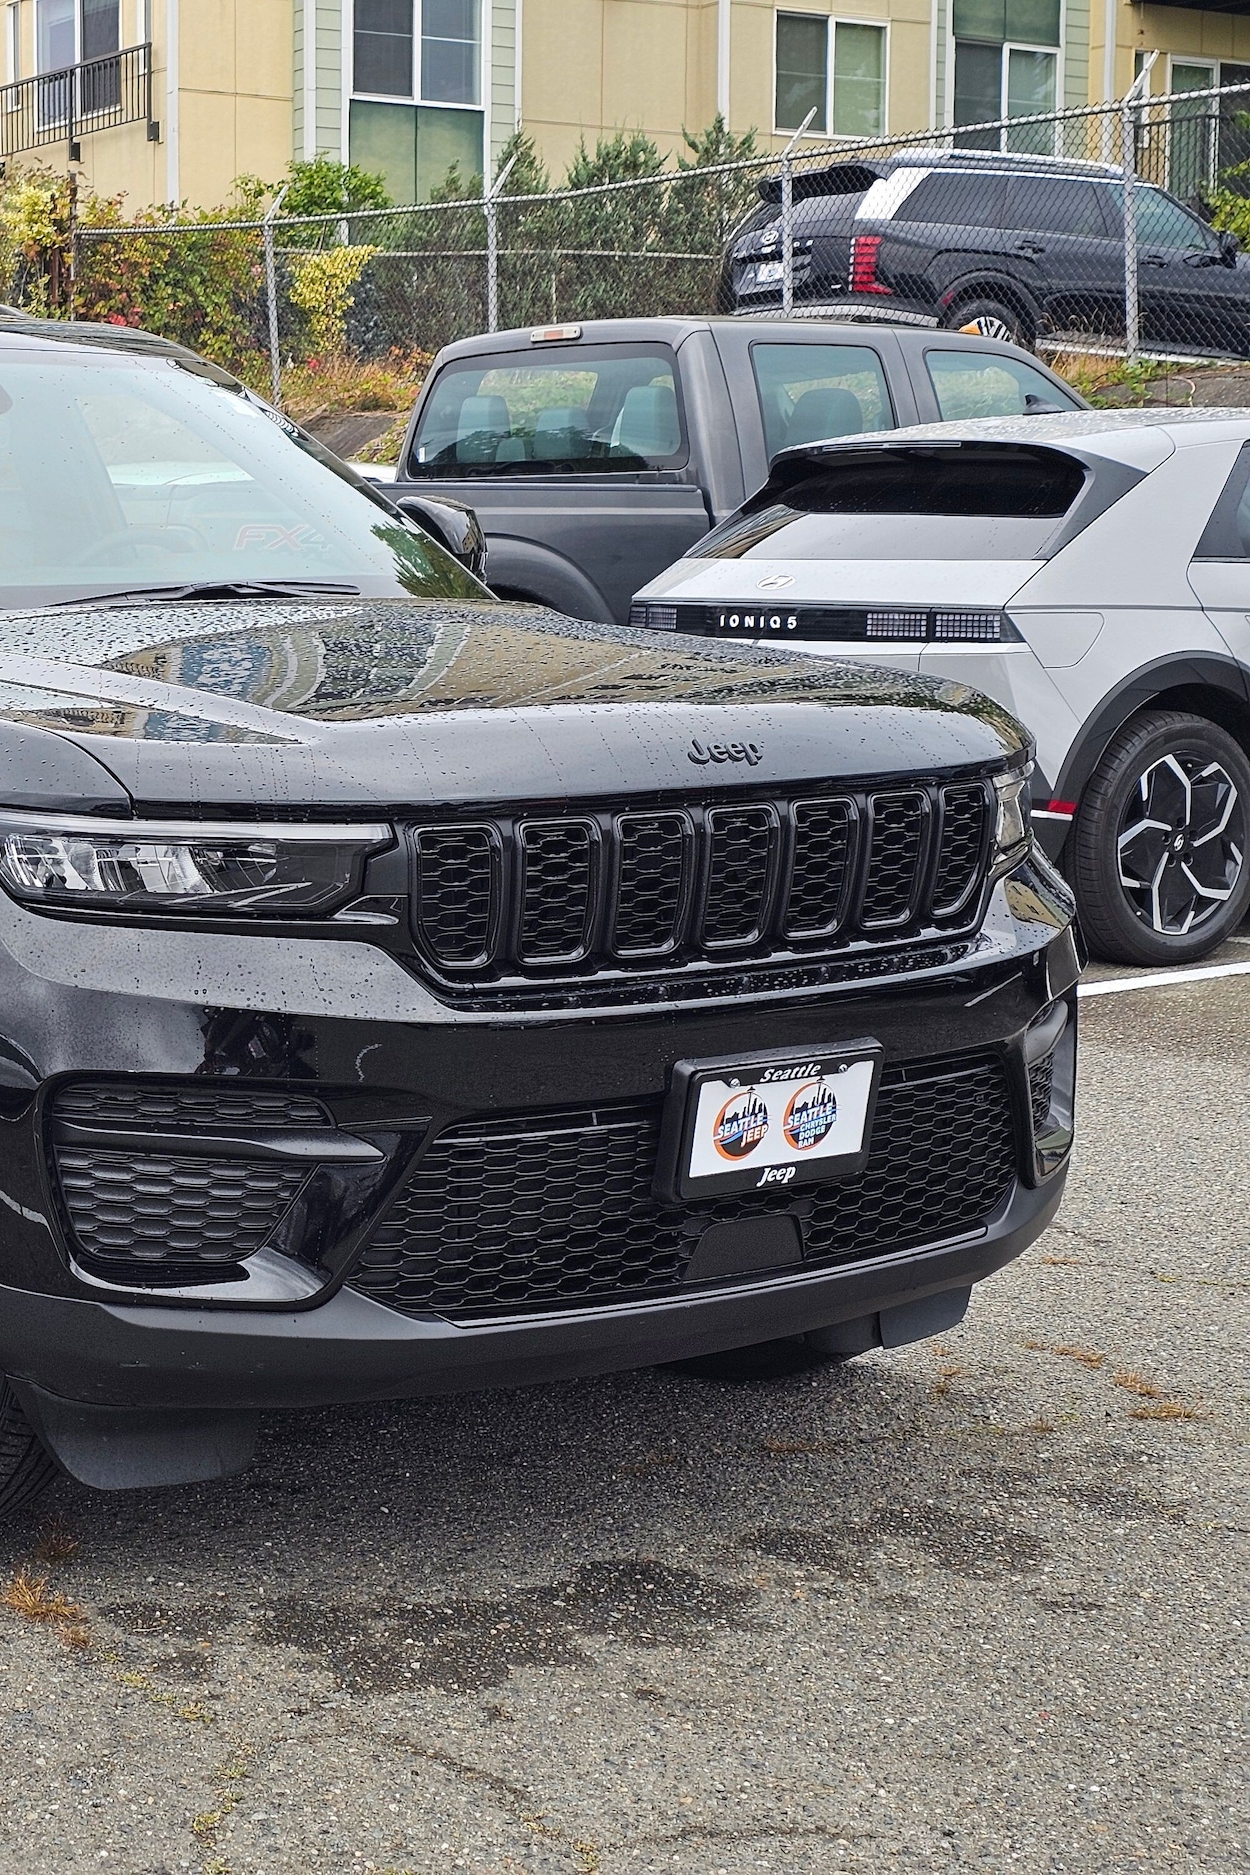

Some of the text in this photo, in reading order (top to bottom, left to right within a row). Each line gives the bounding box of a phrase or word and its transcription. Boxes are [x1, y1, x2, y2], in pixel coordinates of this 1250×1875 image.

[719, 614, 798, 630] IONIQ 5
[687, 738, 763, 766] Jeep
[759, 1062, 822, 1083] Seattle
[716, 1112, 765, 1139] SEATTLE
[787, 1102, 834, 1128] SEATTLE
[800, 1114, 837, 1132] CHRYSLER
[740, 1124, 769, 1148] JEEP
[798, 1125, 826, 1140] DODGE
[798, 1136, 815, 1149] RAM
[755, 1165, 796, 1187] Jeep
